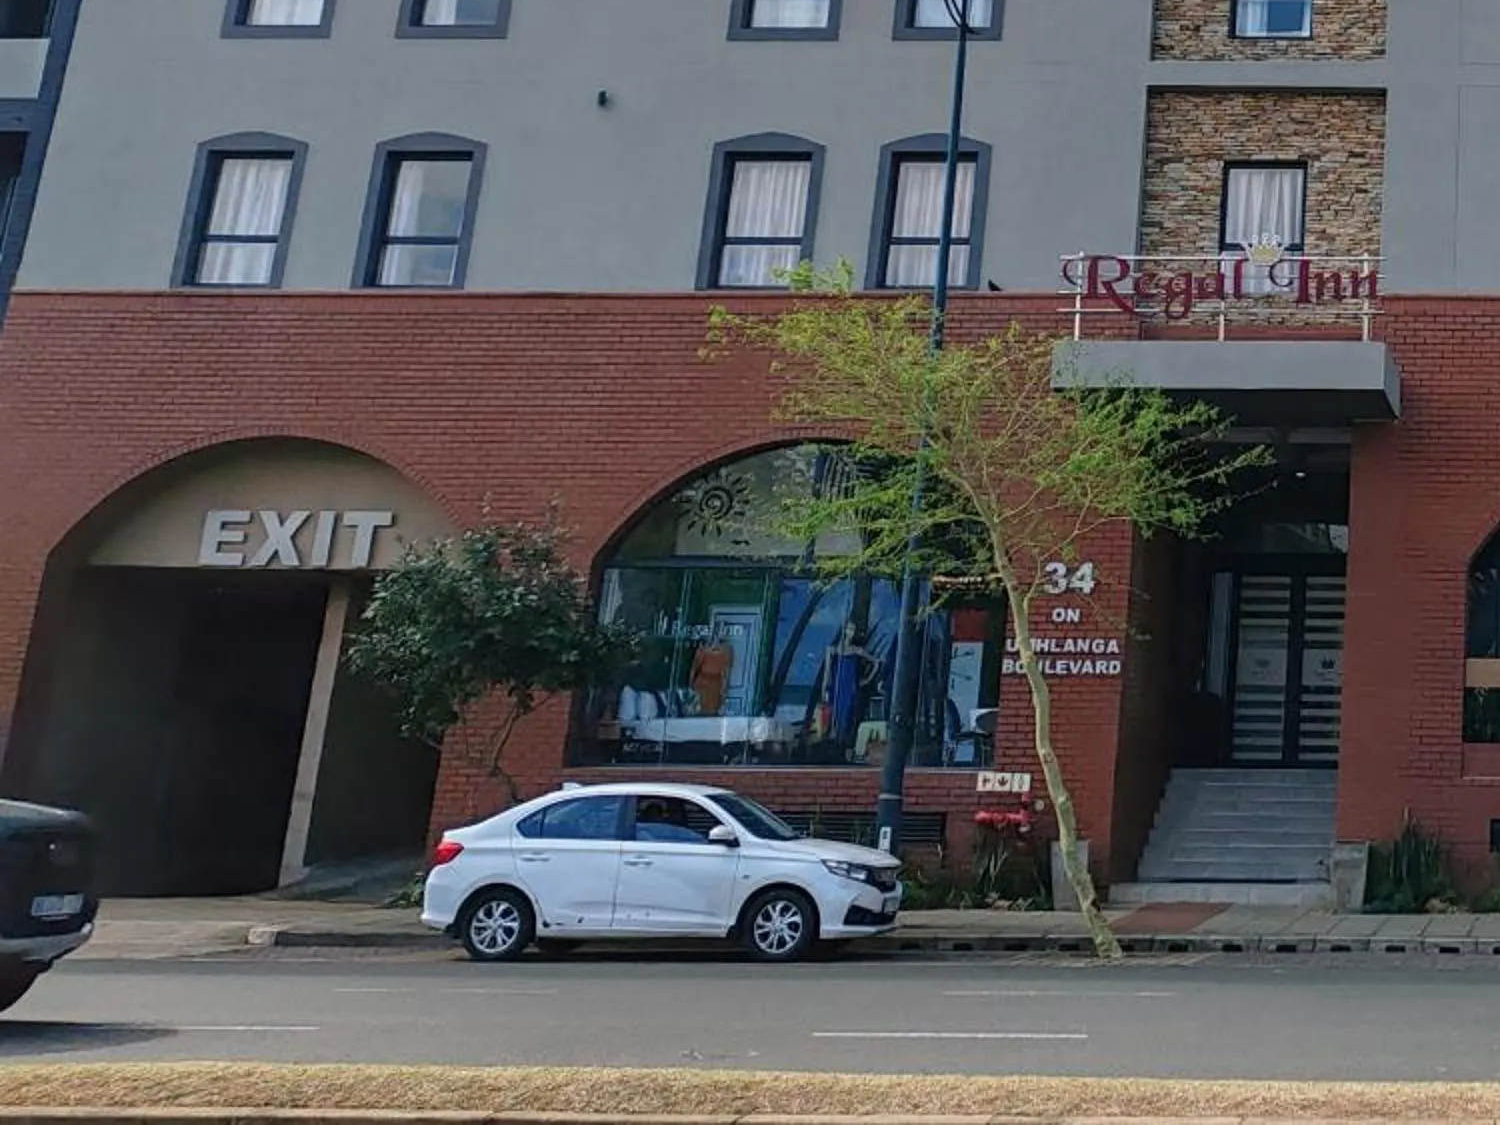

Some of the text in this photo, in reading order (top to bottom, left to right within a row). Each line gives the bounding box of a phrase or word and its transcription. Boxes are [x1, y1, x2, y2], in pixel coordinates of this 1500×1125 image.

[1061, 255, 1380, 319] Regal Inn
[199, 510, 393, 567] EXIT
[1044, 561, 1095, 594] 34
[1052, 607, 1081, 623] ON
[1002, 659, 1121, 675] BOLEVARD
